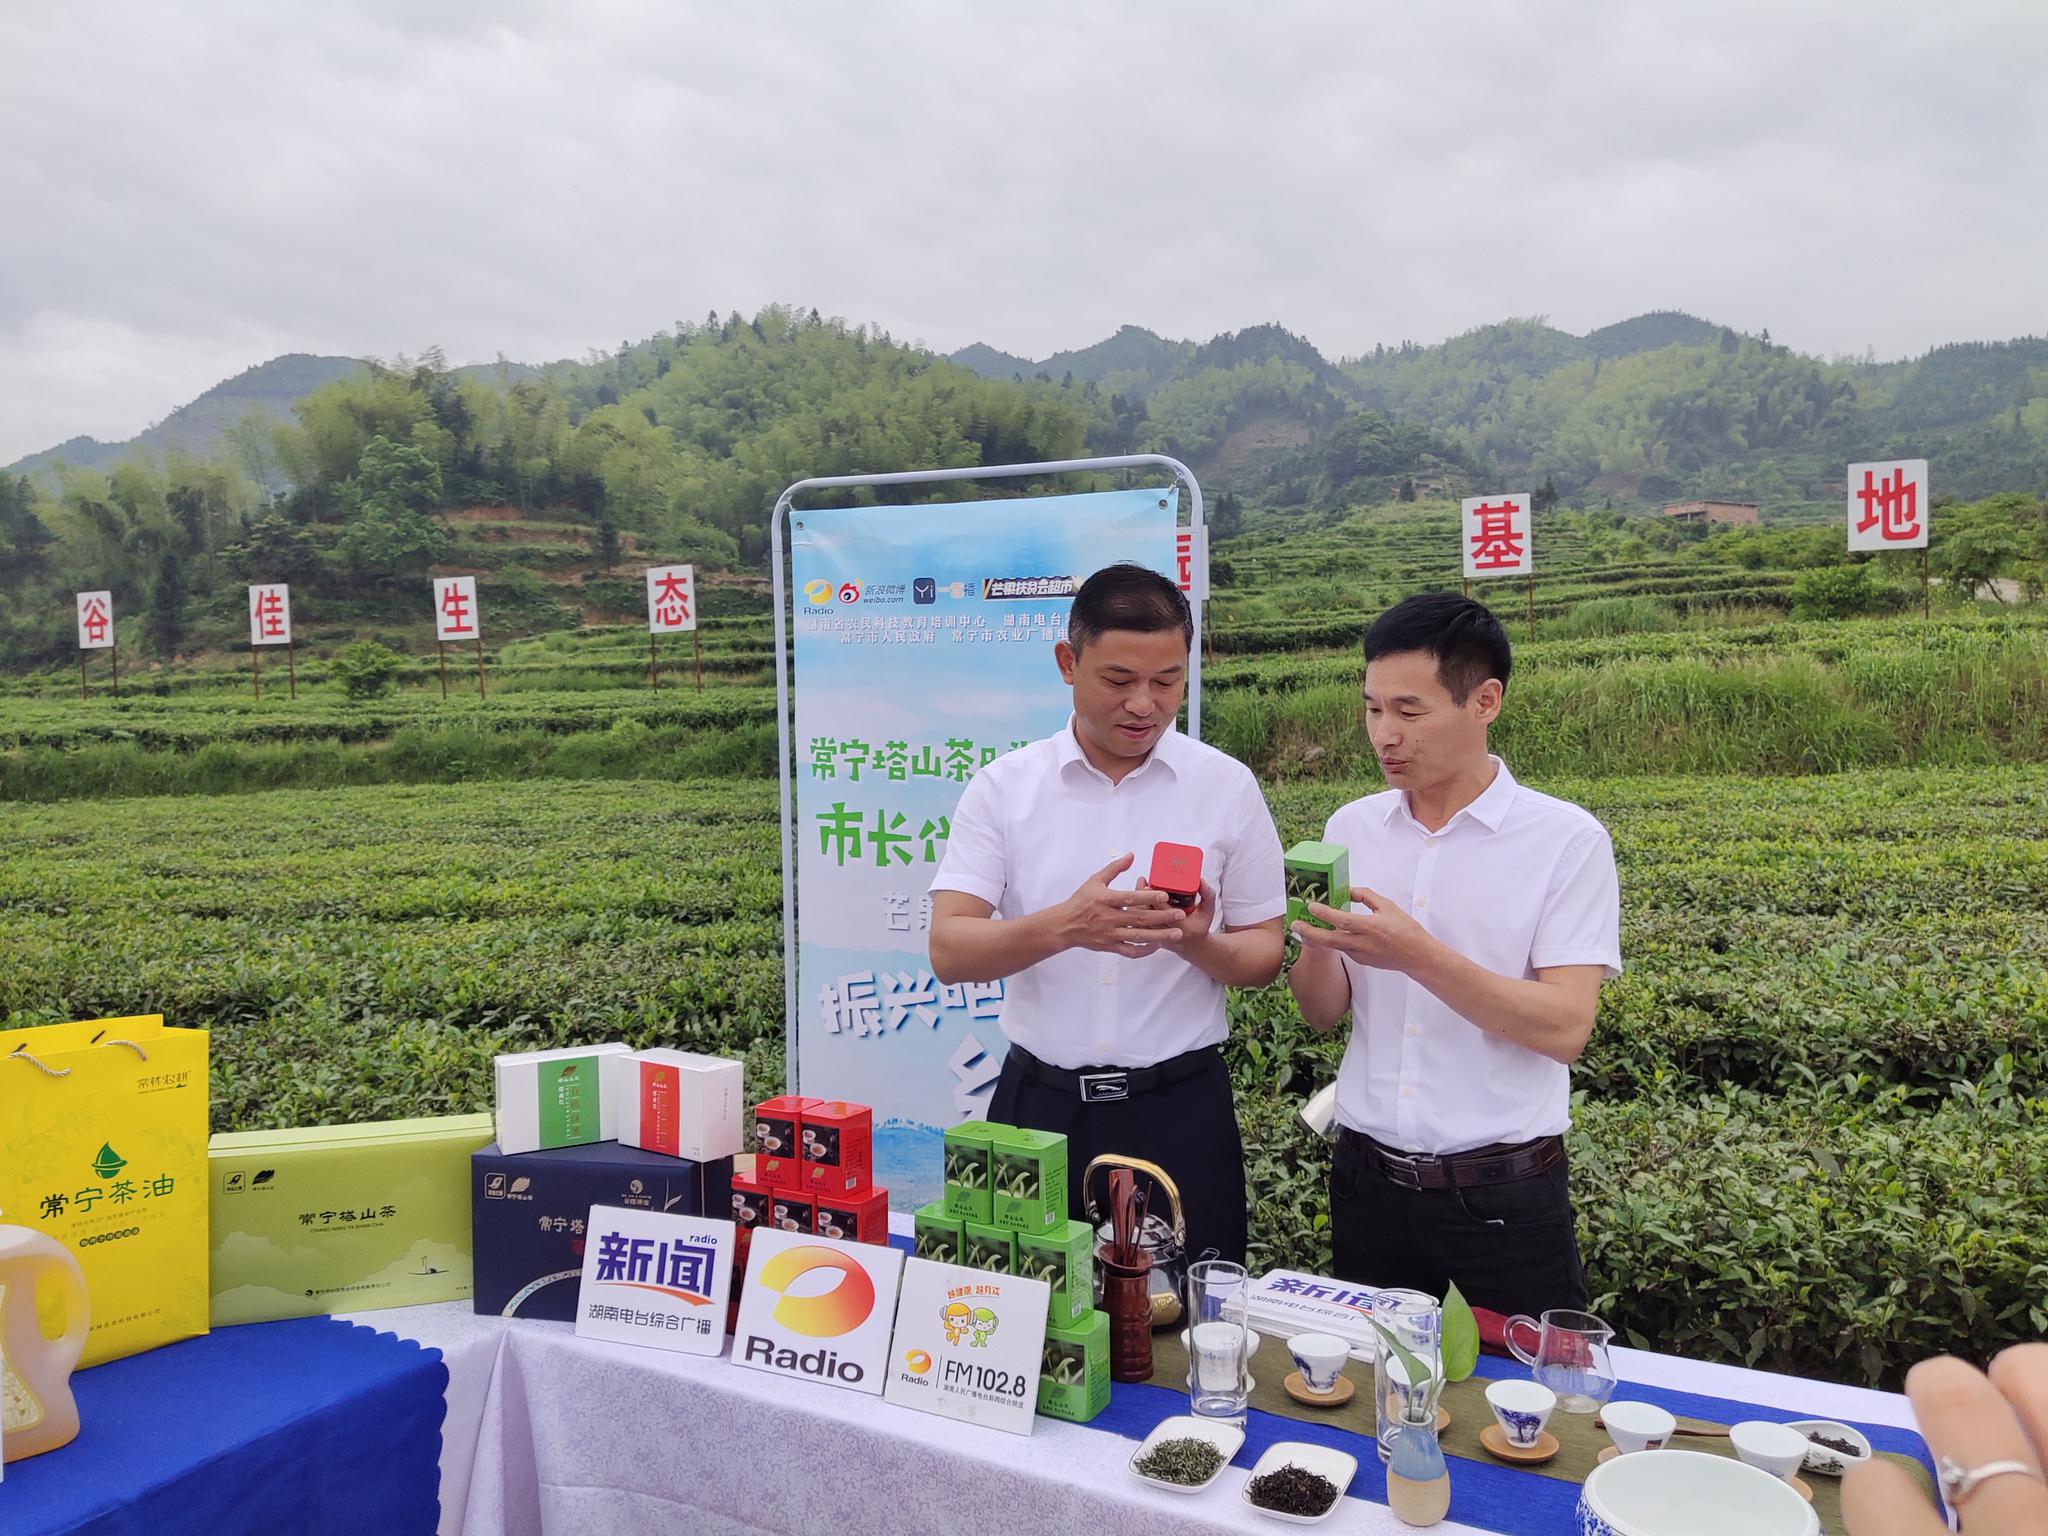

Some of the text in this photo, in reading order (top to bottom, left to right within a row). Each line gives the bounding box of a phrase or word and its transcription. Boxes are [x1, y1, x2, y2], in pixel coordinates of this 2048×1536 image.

[1857, 468, 1921, 542] 地
[1471, 501, 1524, 570] 基
[82, 597, 110, 642] 谷
[255, 588, 286, 637] 佳
[441, 583, 473, 634] 生
[655, 571, 690, 627] 态
[803, 607, 834, 616] Radio
[863, 596, 904, 604] weibo.com
[40, 1173, 175, 1220] 常宁茶油
[298, 1205, 397, 1226] 常宁塔山茶
[689, 1234, 718, 1245] radio
[595, 1231, 716, 1297] 新闻
[588, 1304, 712, 1335] 湖南电台综合广播
[745, 1335, 864, 1383] Radio
[901, 1373, 929, 1387] Radio
